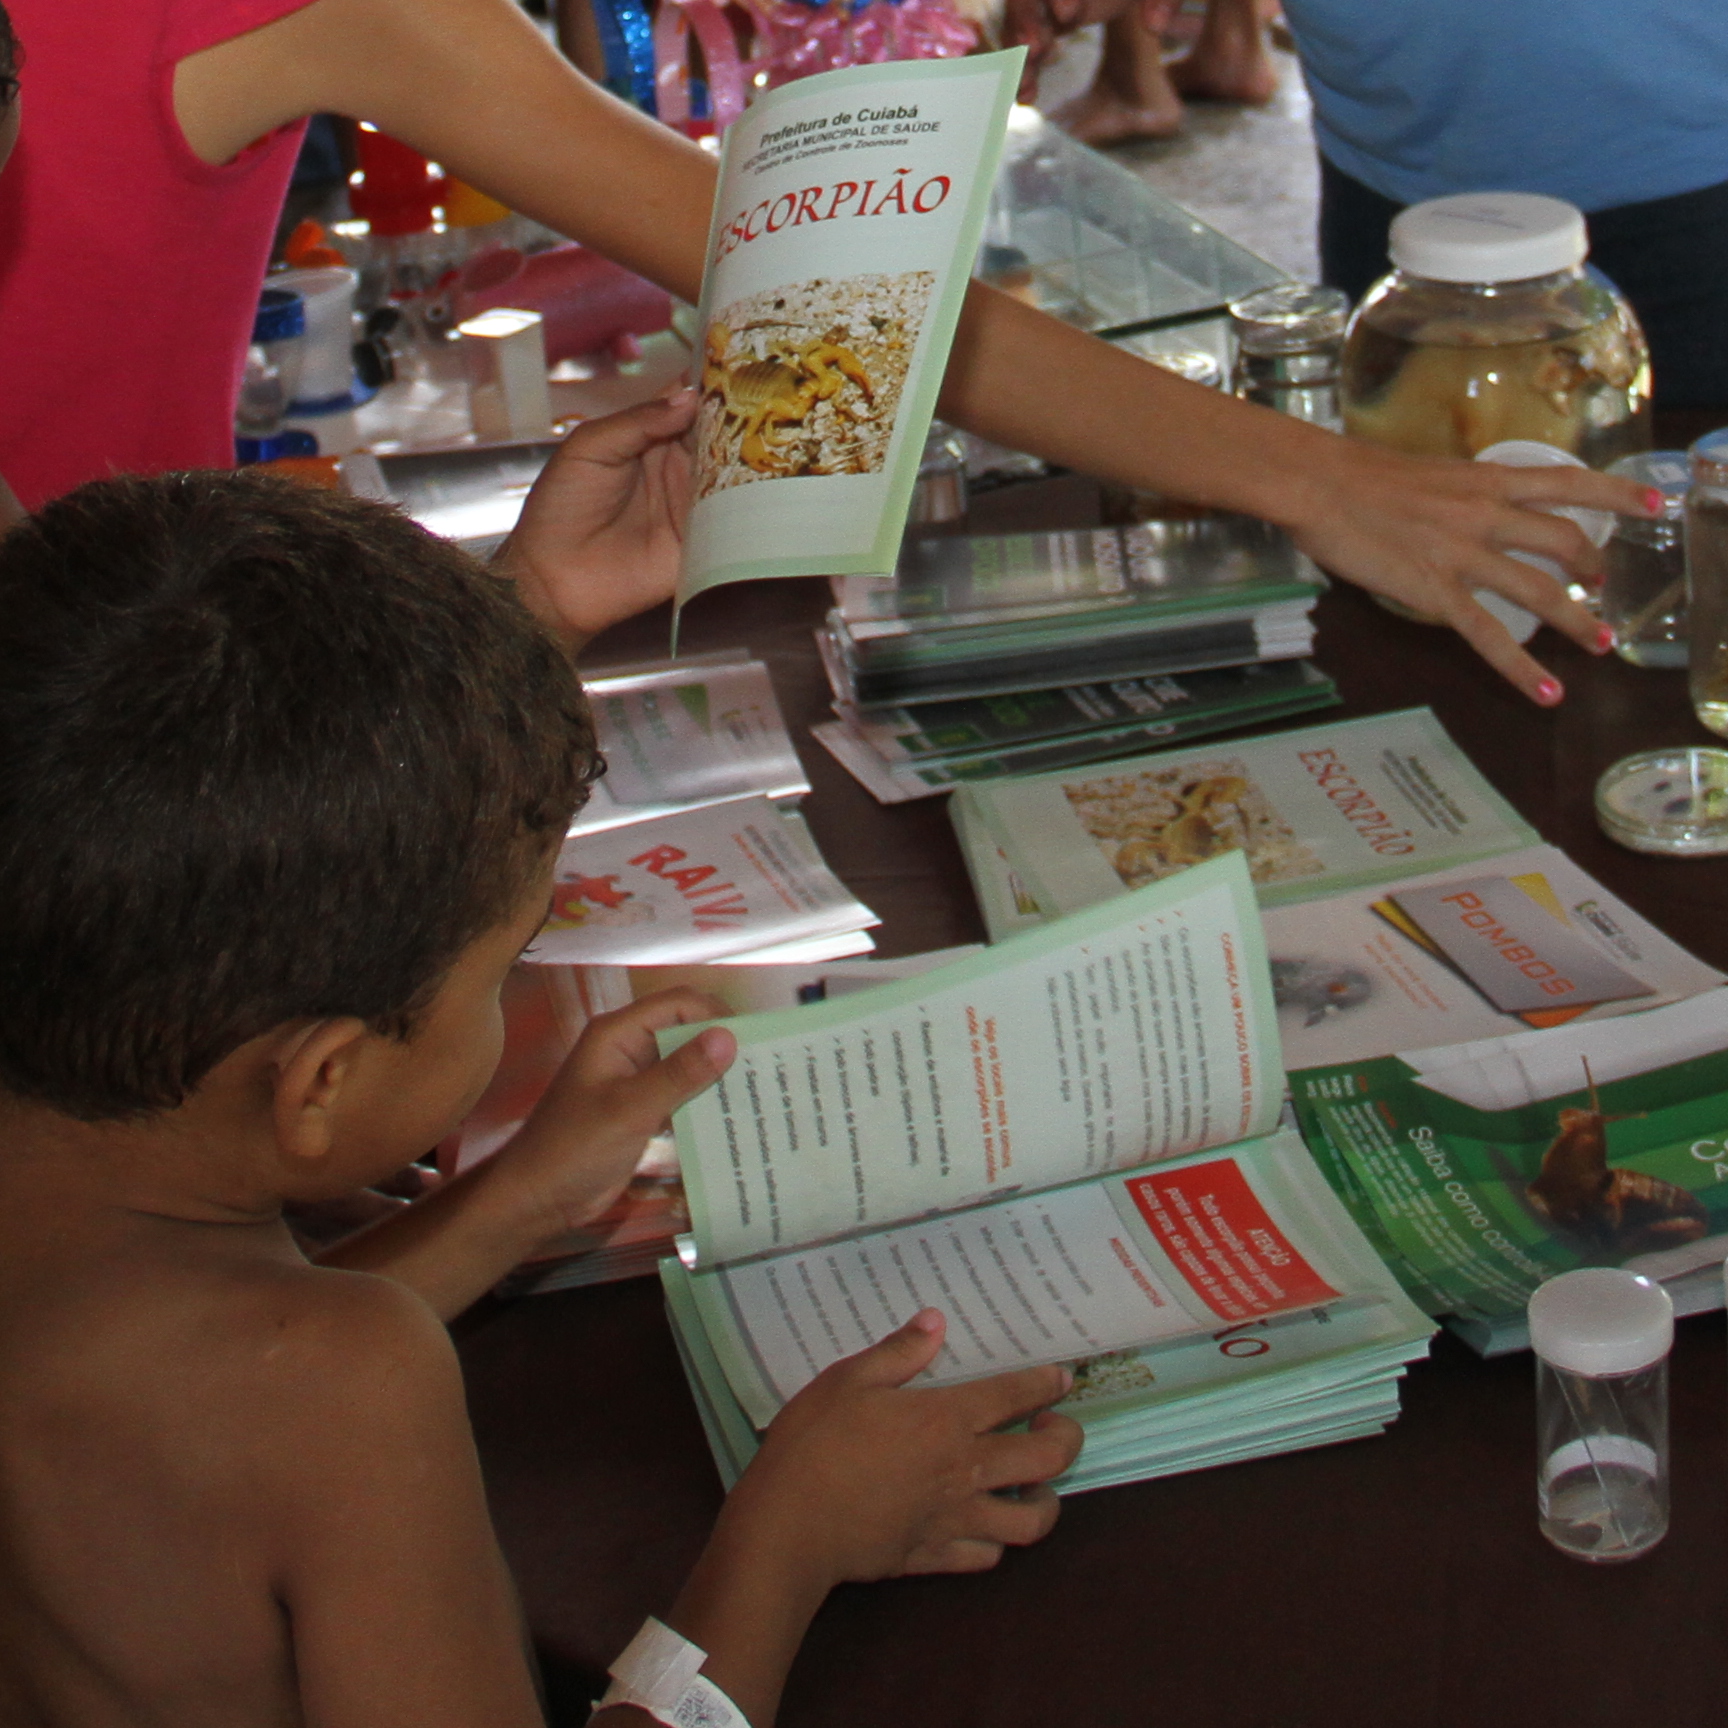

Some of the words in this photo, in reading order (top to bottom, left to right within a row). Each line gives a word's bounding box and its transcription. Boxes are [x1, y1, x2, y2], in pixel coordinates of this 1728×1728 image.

[760, 117, 828, 148] Prefeitura
[832, 112, 852, 126] de
[857, 105, 919, 123] Cuiabá
[802, 126, 867, 147] MUNICIPAL
[871, 124, 889, 136] DE
[893, 120, 941, 135] SAÚDE
[855, 137, 910, 149] Zoonoses
[714, 167, 951, 265] ESCORPIÃO
[1298, 747, 1416, 858] ESCORPIÃO
[1439, 890, 1574, 1000] POMBOS
[964, 1005, 980, 1035] onde
[1232, 1011, 1247, 1052] POUCO
[864, 1061, 880, 1097] pedras
[969, 1054, 992, 1119] escorpiões
[990, 1062, 1004, 1097] locais
[1237, 1053, 1252, 1088] SOBRE
[994, 1099, 1008, 1125] mais
[723, 1116, 743, 1169] dobradas
[1139, 1183, 1160, 1208] casos
[1408, 1124, 1454, 1179] Saiba
[1445, 1177, 1488, 1233] como
[1199, 1194, 1219, 1218] Todo
[1249, 1228, 1290, 1266] ATENÇÃO
